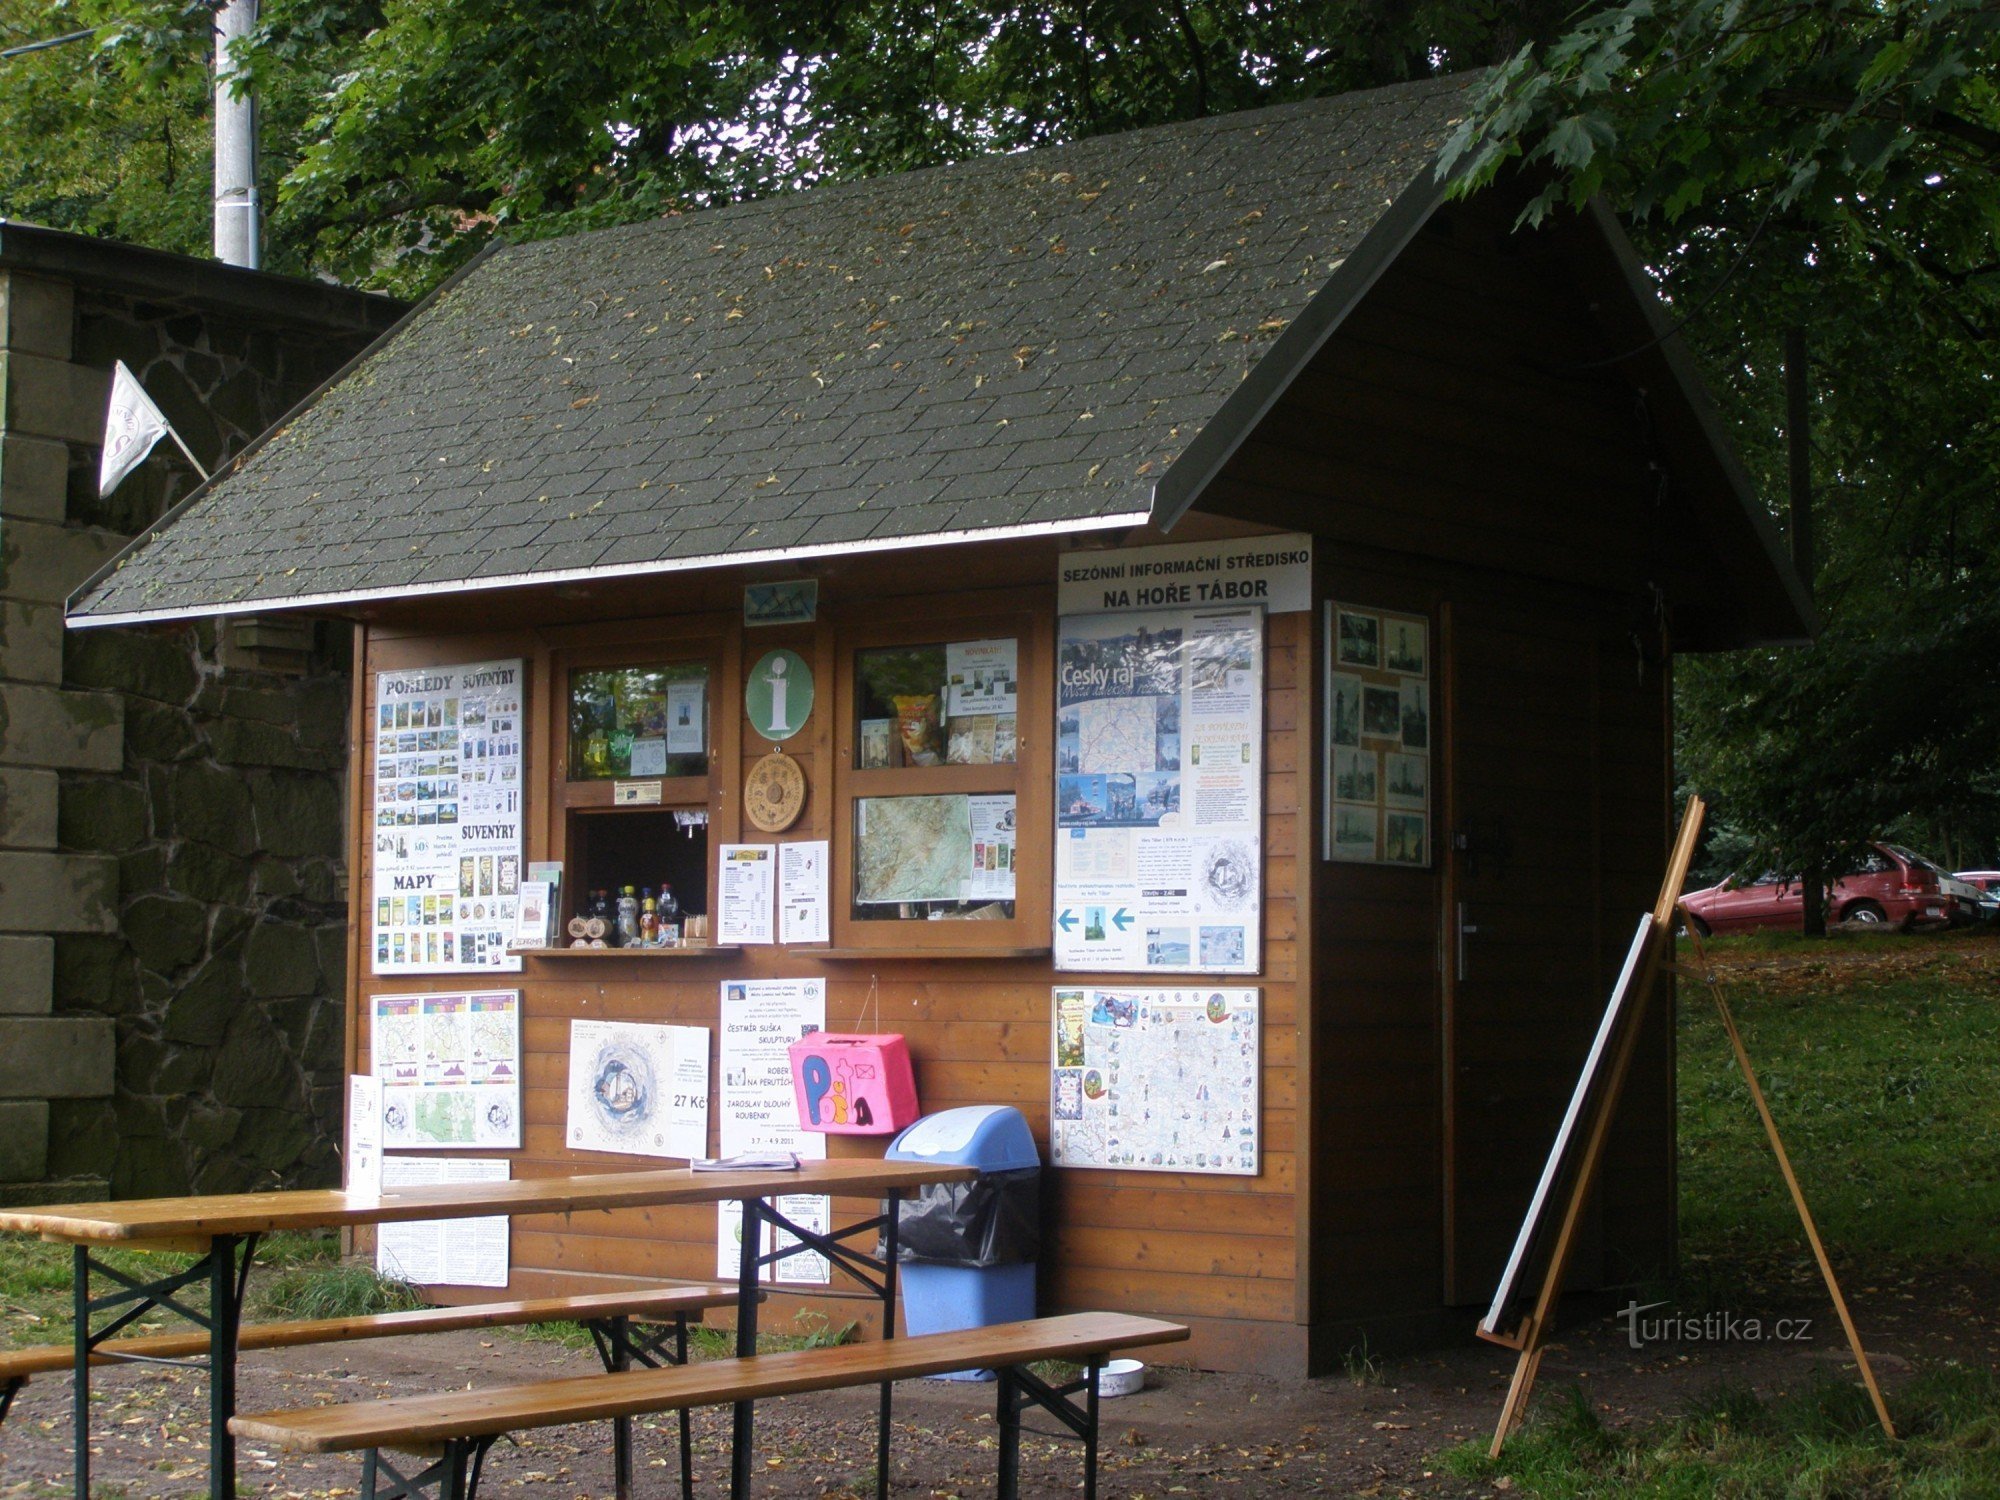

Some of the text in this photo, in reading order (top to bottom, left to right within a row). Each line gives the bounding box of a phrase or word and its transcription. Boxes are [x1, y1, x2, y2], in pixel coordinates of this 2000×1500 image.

[1063, 550, 1310, 583] SEZÓNNÍ INFORMAČNÍ STŘEDISKO
[1103, 579, 1269, 608] NA HOŘE TÁBOR
[1061, 661, 1109, 690] Český
[386, 675, 454, 696] POHLEDY
[462, 819, 516, 839] SUVENÝRY
[393, 874, 435, 890] MAPY
[727, 1022, 782, 1033] ČESTMÍR SUŠKA
[758, 1036, 796, 1045] SKULPTURY
[674, 1094, 705, 1109] 27 Kč
[727, 1098, 791, 1108] JAROSLAV DLOUHÝ
[735, 1111, 771, 1120] ROUBENKY
